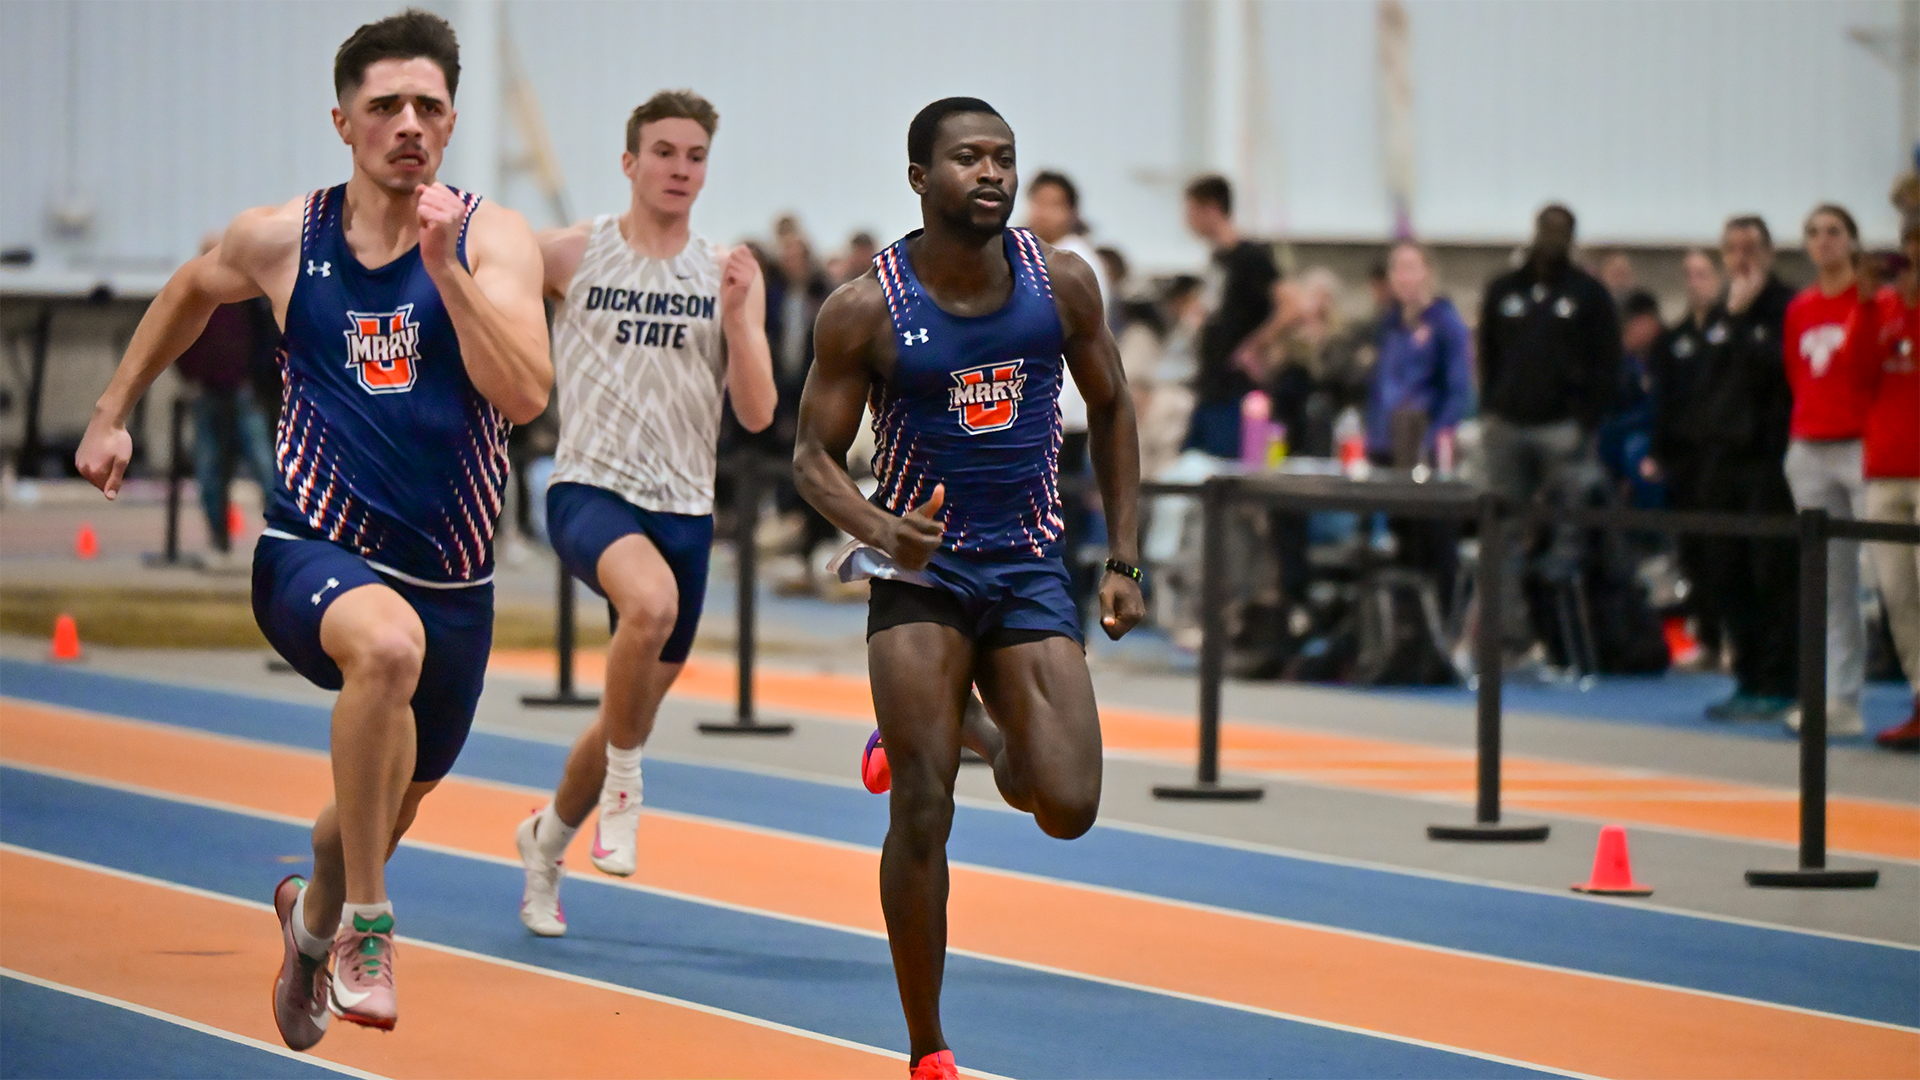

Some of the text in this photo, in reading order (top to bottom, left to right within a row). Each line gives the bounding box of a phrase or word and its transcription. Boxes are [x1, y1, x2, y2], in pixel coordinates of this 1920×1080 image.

[586, 286, 716, 320] DICKINSON
[350, 327, 415, 363] MARY
[615, 320, 688, 350] STATE
[953, 379, 1023, 407] MARY
